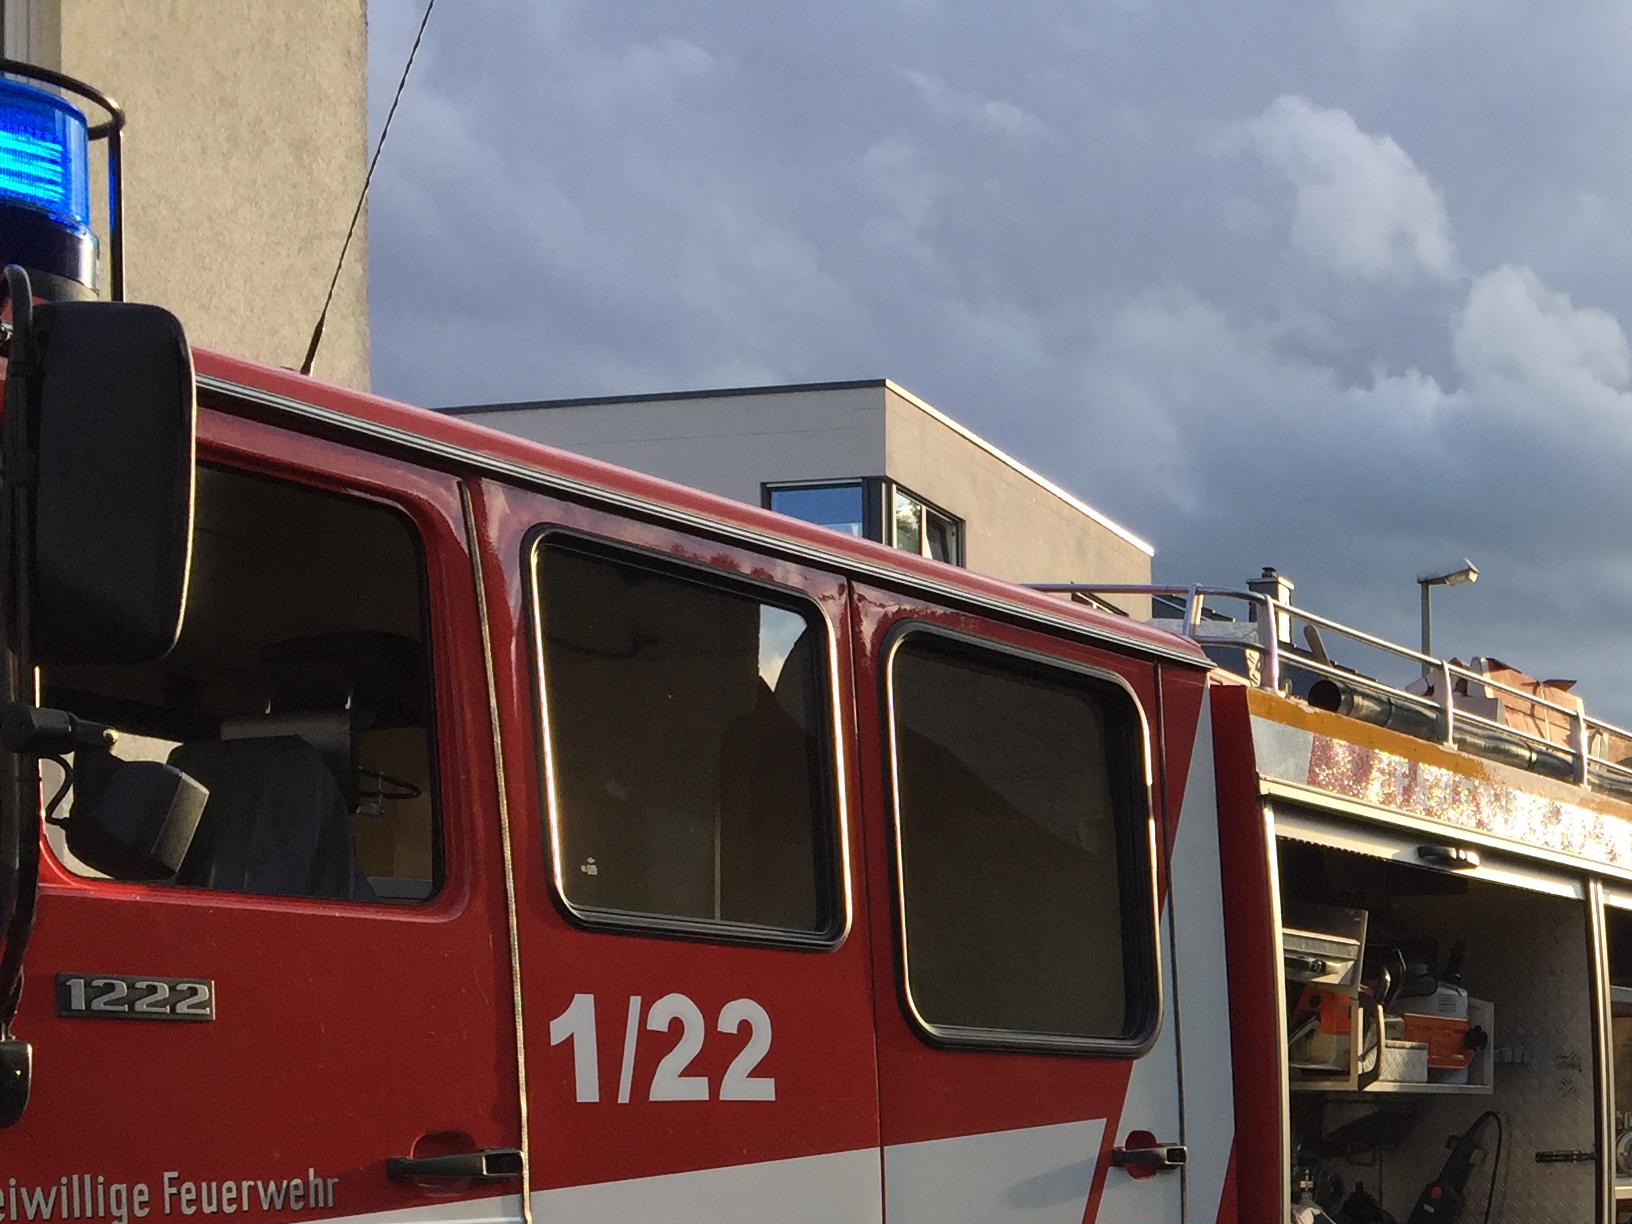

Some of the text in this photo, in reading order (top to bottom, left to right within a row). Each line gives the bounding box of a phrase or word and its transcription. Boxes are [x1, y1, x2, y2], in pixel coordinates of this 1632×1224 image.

[65, 978, 211, 1015] 1222
[549, 993, 776, 1104] 1/22
[163, 1168, 340, 1215] Feuerwehr
